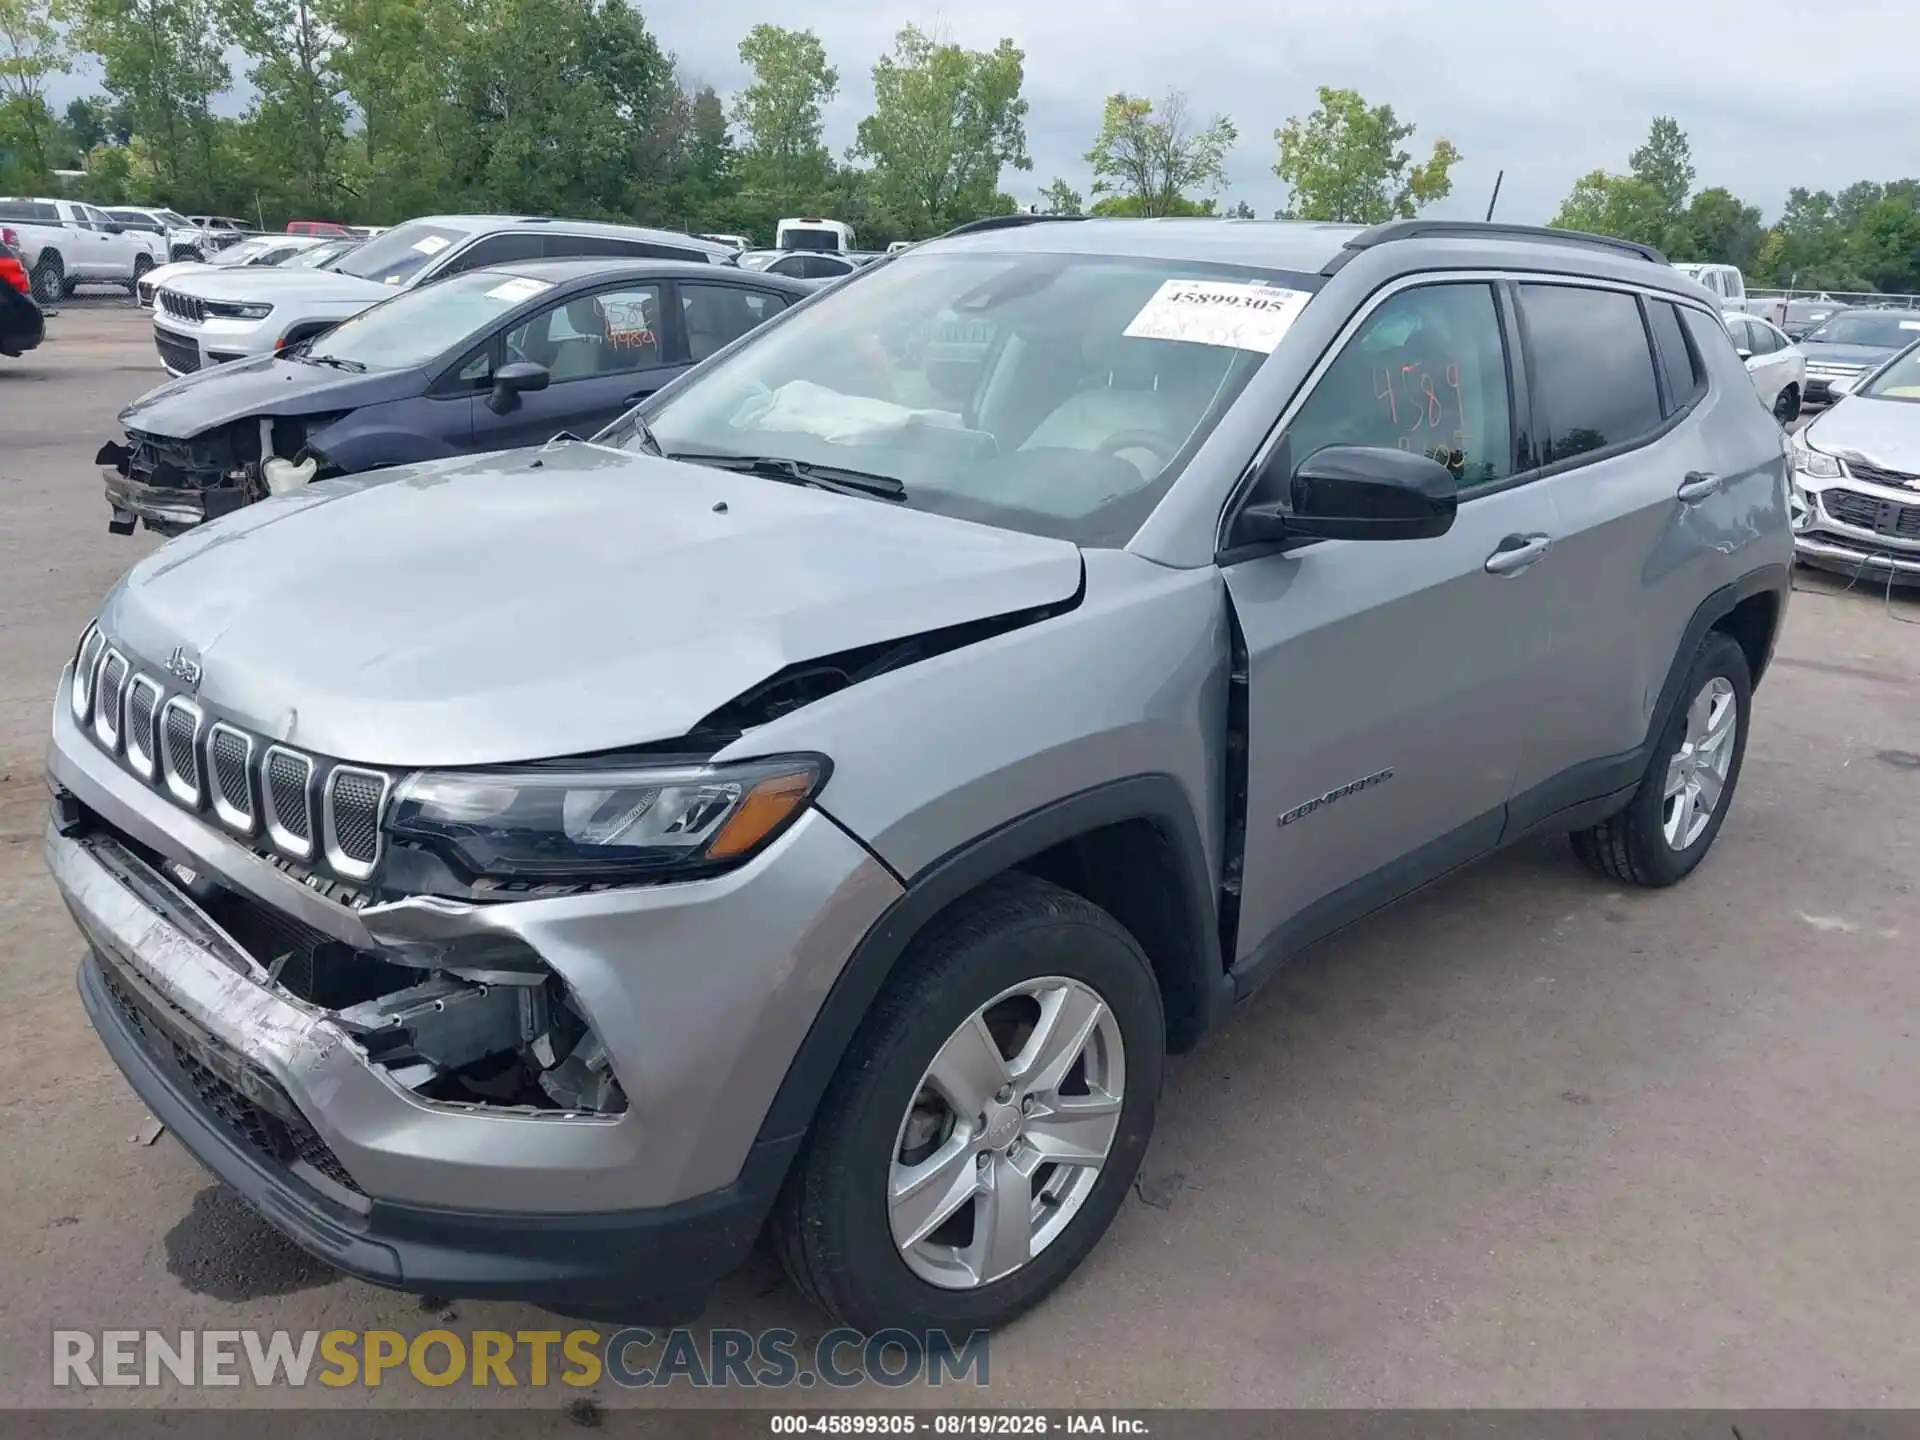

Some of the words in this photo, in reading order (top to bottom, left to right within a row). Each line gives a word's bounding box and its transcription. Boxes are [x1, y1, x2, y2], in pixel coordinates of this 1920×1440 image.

[1168, 290, 1286, 313] 45899305
[1372, 361, 1465, 432] 4589
[1277, 765, 1395, 827] COMPASS
